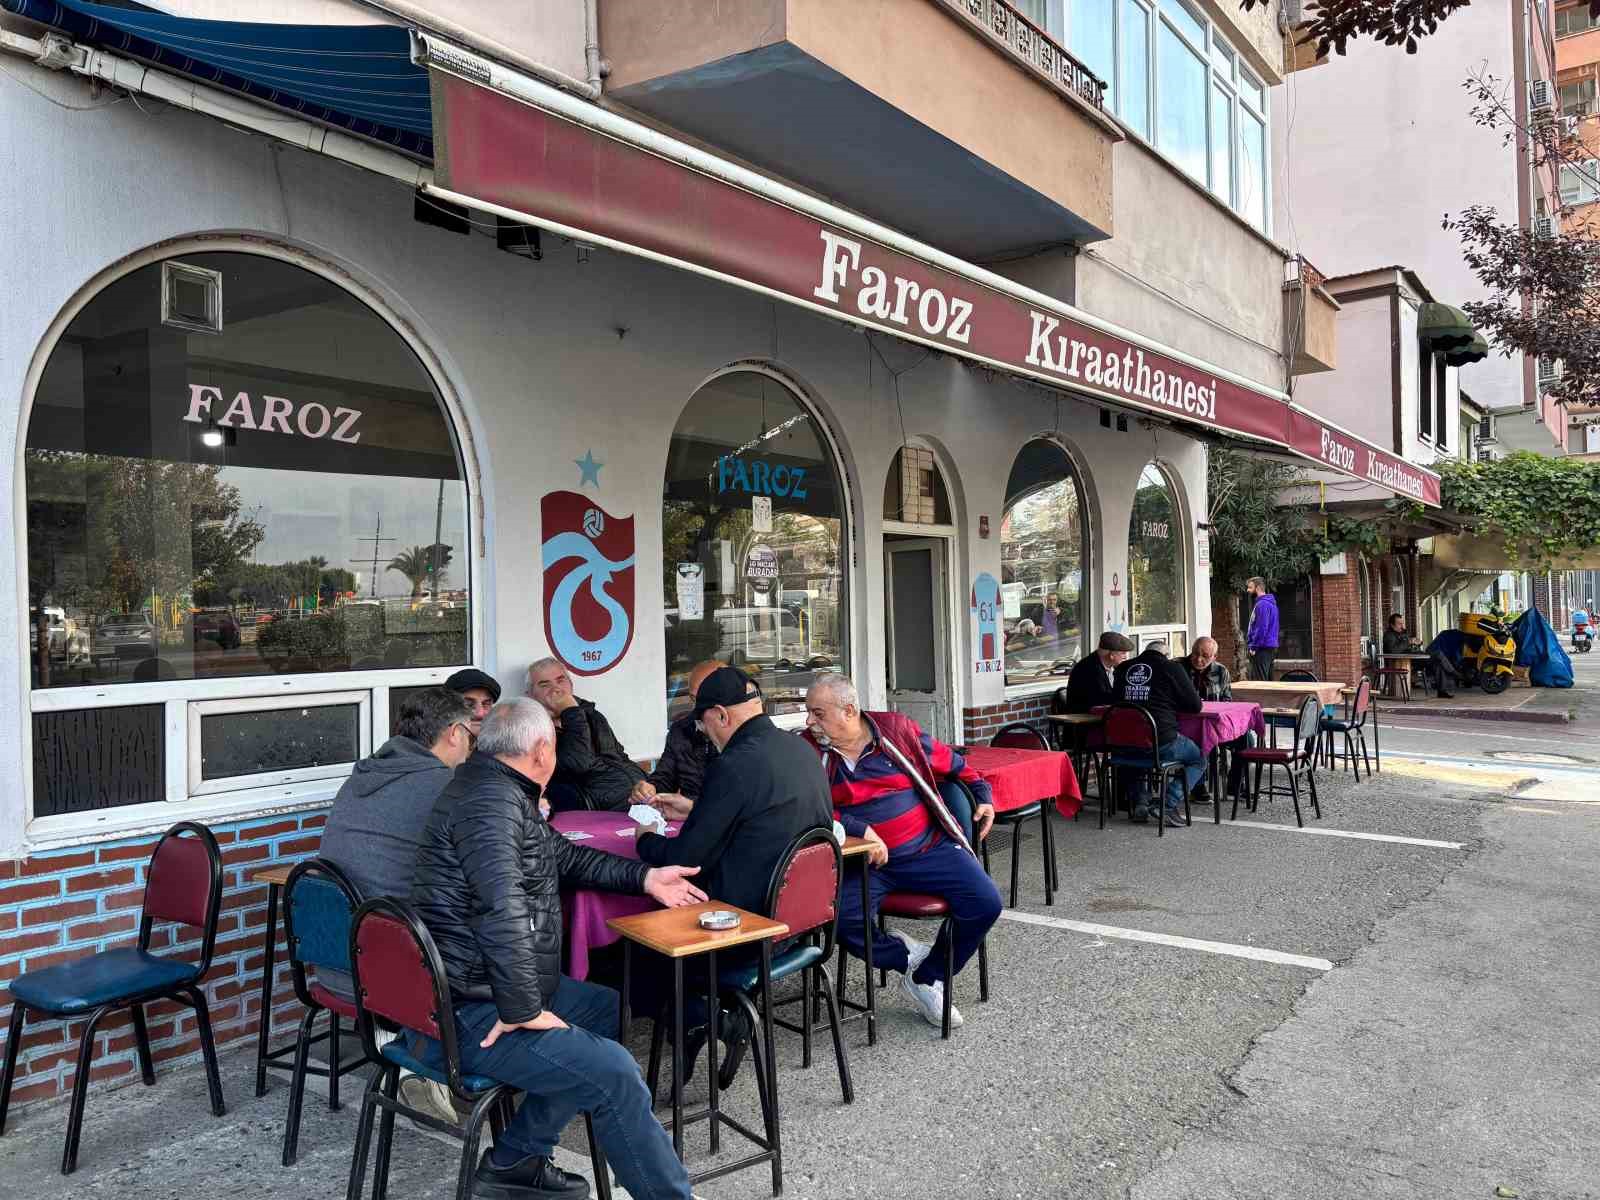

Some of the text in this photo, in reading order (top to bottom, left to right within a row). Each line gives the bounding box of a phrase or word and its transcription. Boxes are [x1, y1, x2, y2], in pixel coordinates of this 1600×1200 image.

[814, 229, 1217, 420] Faroz Kıraathanesi
[183, 383, 362, 444] FAROZ
[719, 456, 808, 500] FAROZ
[1321, 427, 1424, 498] Faroz Kıraathanesi
[1142, 520, 1169, 539] FAROZ
[980, 601, 994, 622] 61
[582, 650, 602, 661] 1967
[975, 660, 1002, 673] FAROZ
